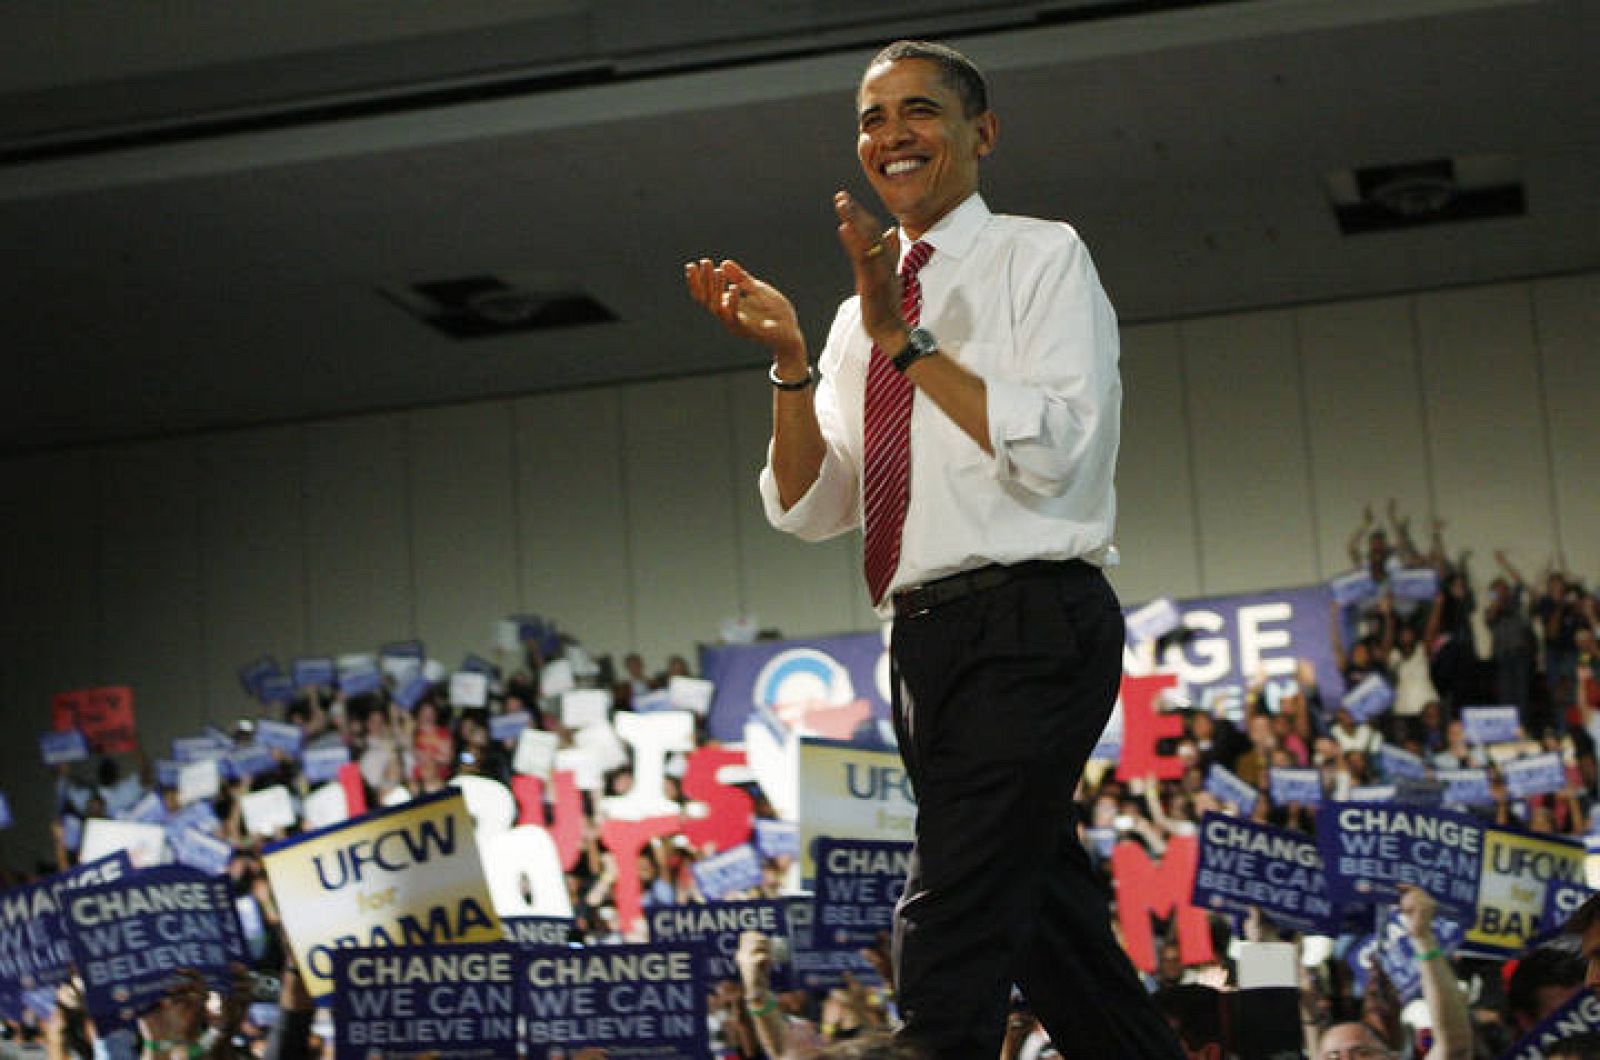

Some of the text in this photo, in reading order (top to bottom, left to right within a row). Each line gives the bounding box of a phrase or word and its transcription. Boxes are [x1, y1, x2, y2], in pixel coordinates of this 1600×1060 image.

[1206, 820, 1322, 869] CHANG
[1339, 808, 1480, 853] CHANGE
[314, 815, 457, 891] UFCW
[1205, 845, 1255, 877] WE
[1339, 831, 1476, 880] WE CAN
[1339, 856, 1446, 894] BELIEVE
[71, 882, 213, 926] CHANGE
[653, 906, 777, 937] CHANGE
[79, 919, 149, 957] WE
[348, 952, 513, 987] CHANGE
[528, 952, 693, 987] CHANGE
[349, 984, 513, 1019] WE CAN
[529, 983, 694, 1018] WE CAN
[348, 1016, 513, 1044] BELIEVE IN
[528, 1013, 694, 1043] BELIEVE IN
